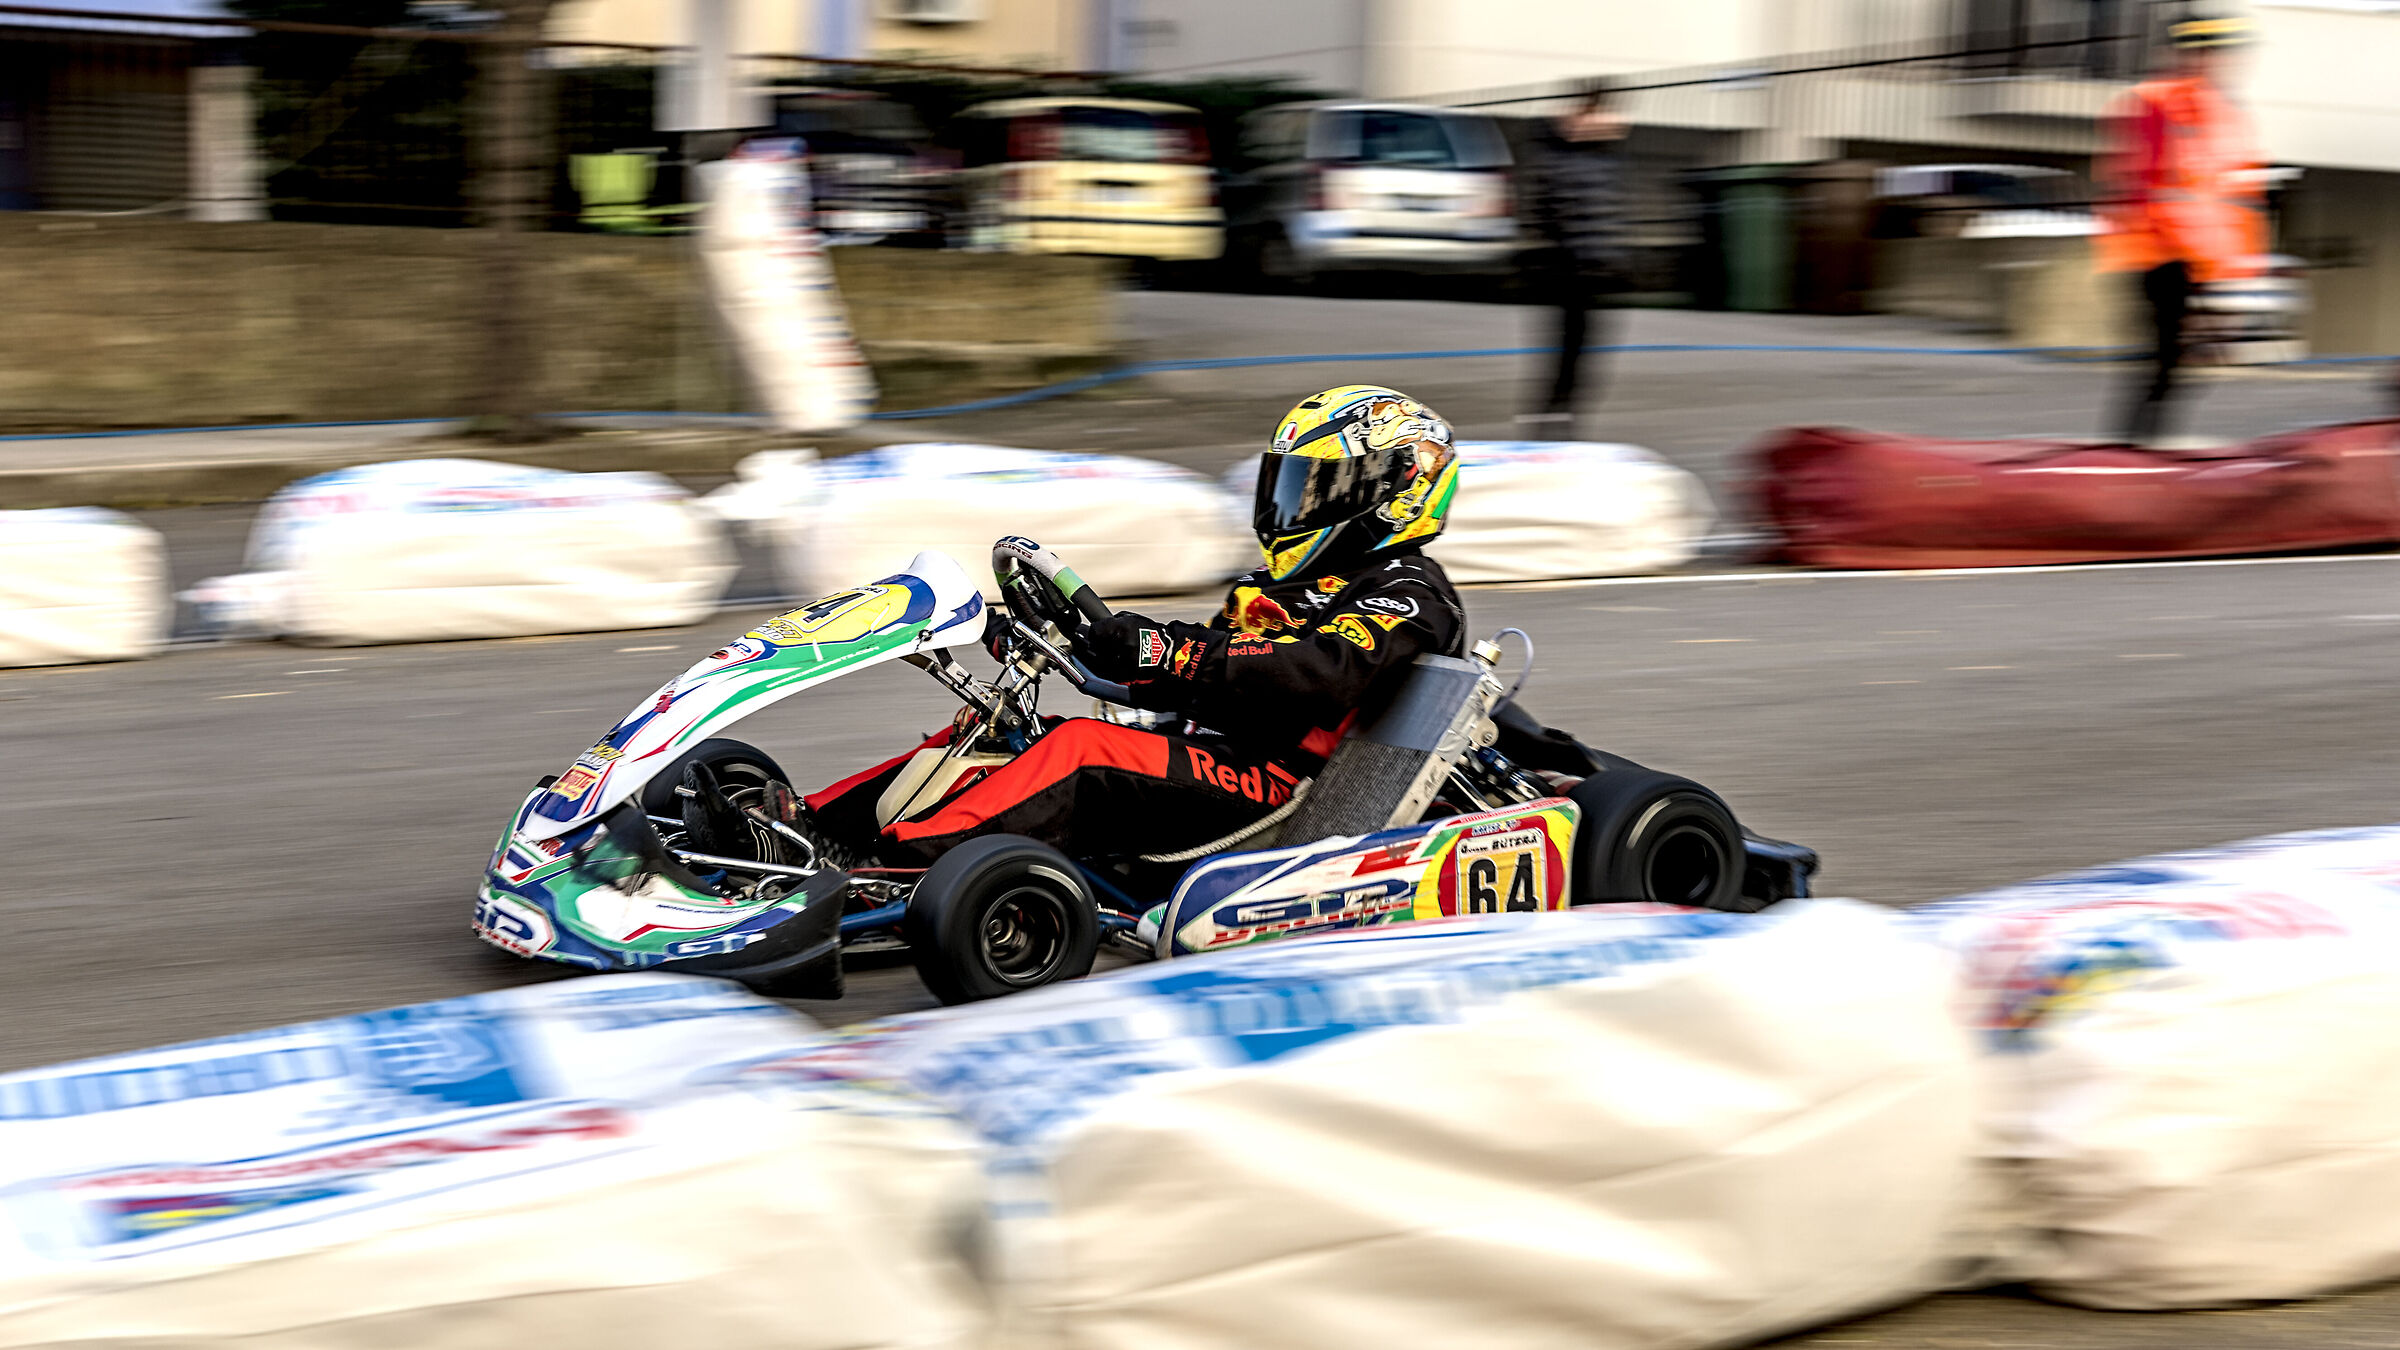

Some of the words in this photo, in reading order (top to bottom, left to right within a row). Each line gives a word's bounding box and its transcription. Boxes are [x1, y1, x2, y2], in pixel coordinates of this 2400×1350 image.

[1141, 635, 1152, 661] TAG
[1151, 631, 1163, 664] HEUER
[1185, 745, 1263, 803] Red
[1469, 852, 1538, 914] 64
